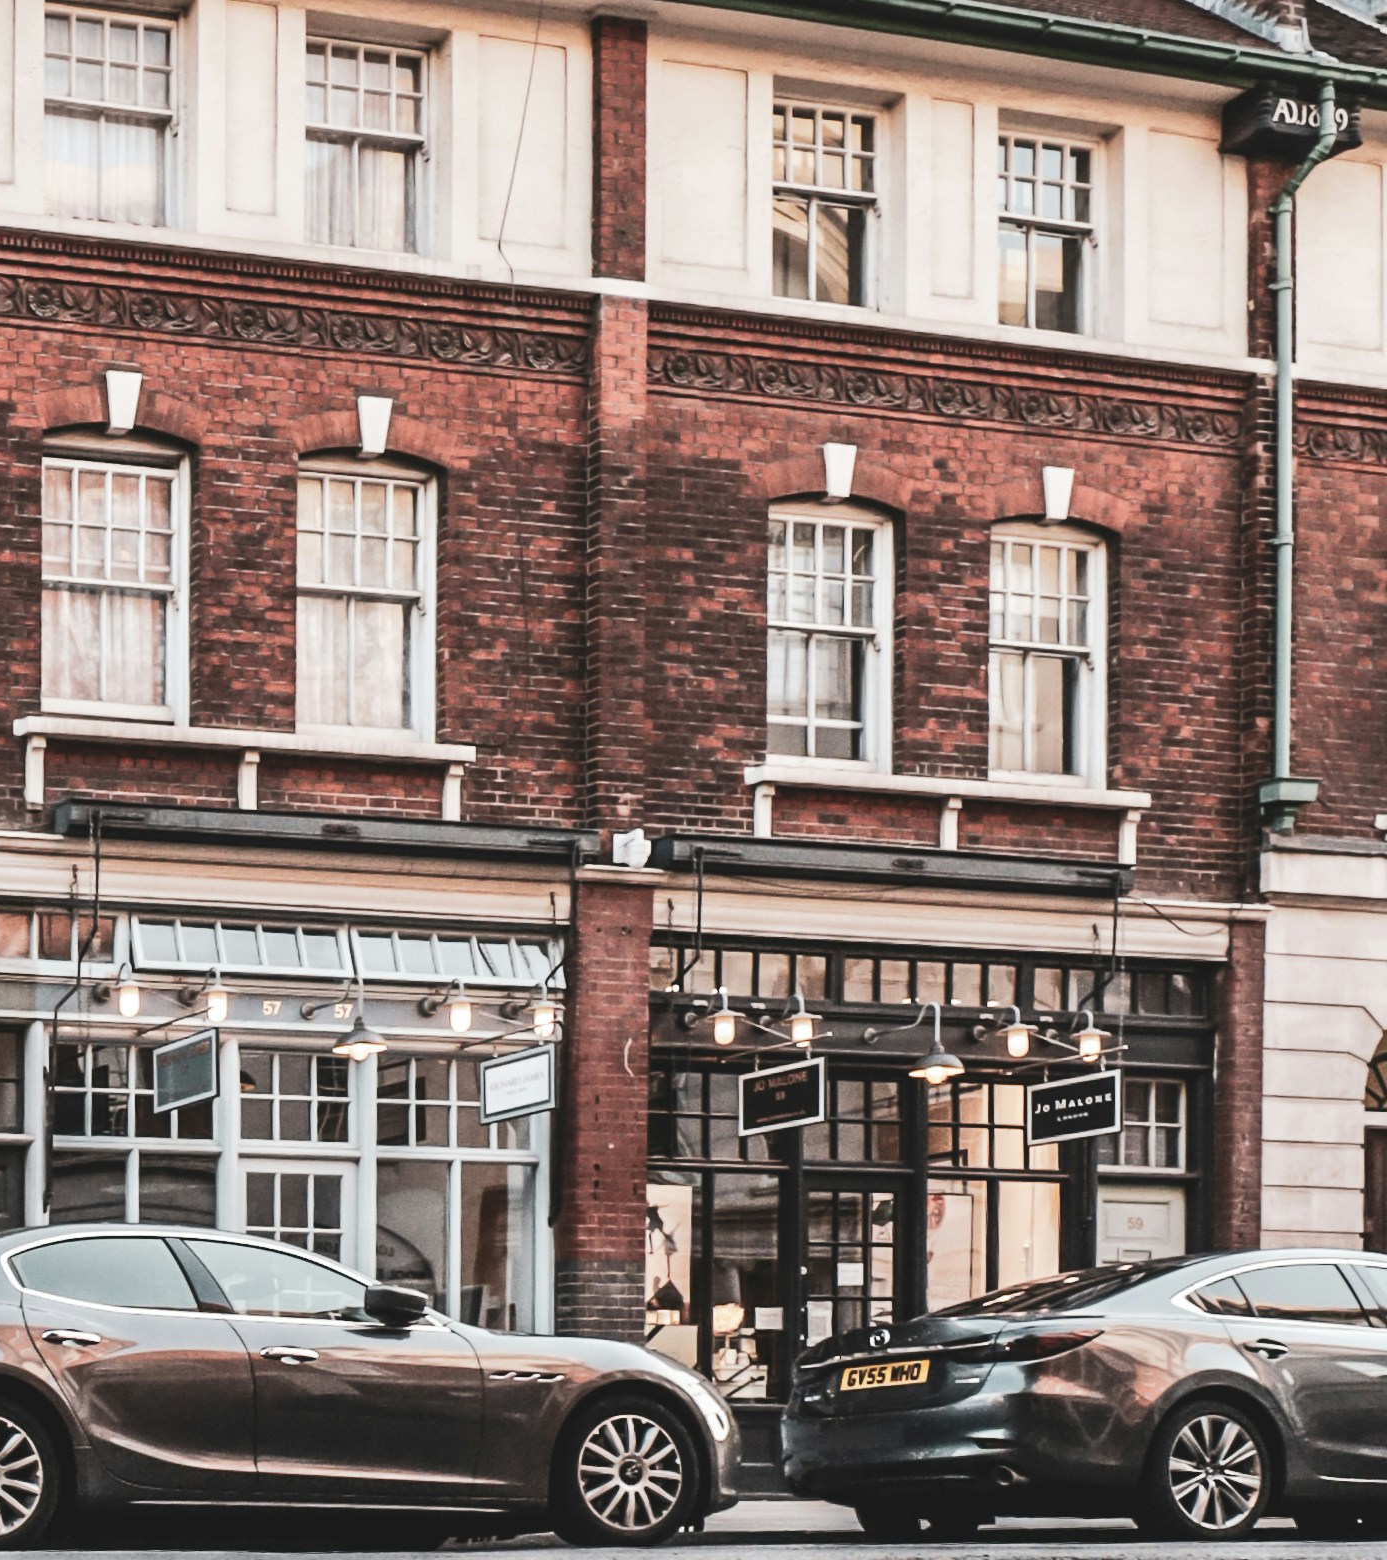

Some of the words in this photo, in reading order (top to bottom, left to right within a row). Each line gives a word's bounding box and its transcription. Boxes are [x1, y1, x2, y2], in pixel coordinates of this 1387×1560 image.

[263, 1001, 282, 1016] 57
[334, 1003, 353, 1019] 57
[1128, 1217, 1144, 1230] 59
